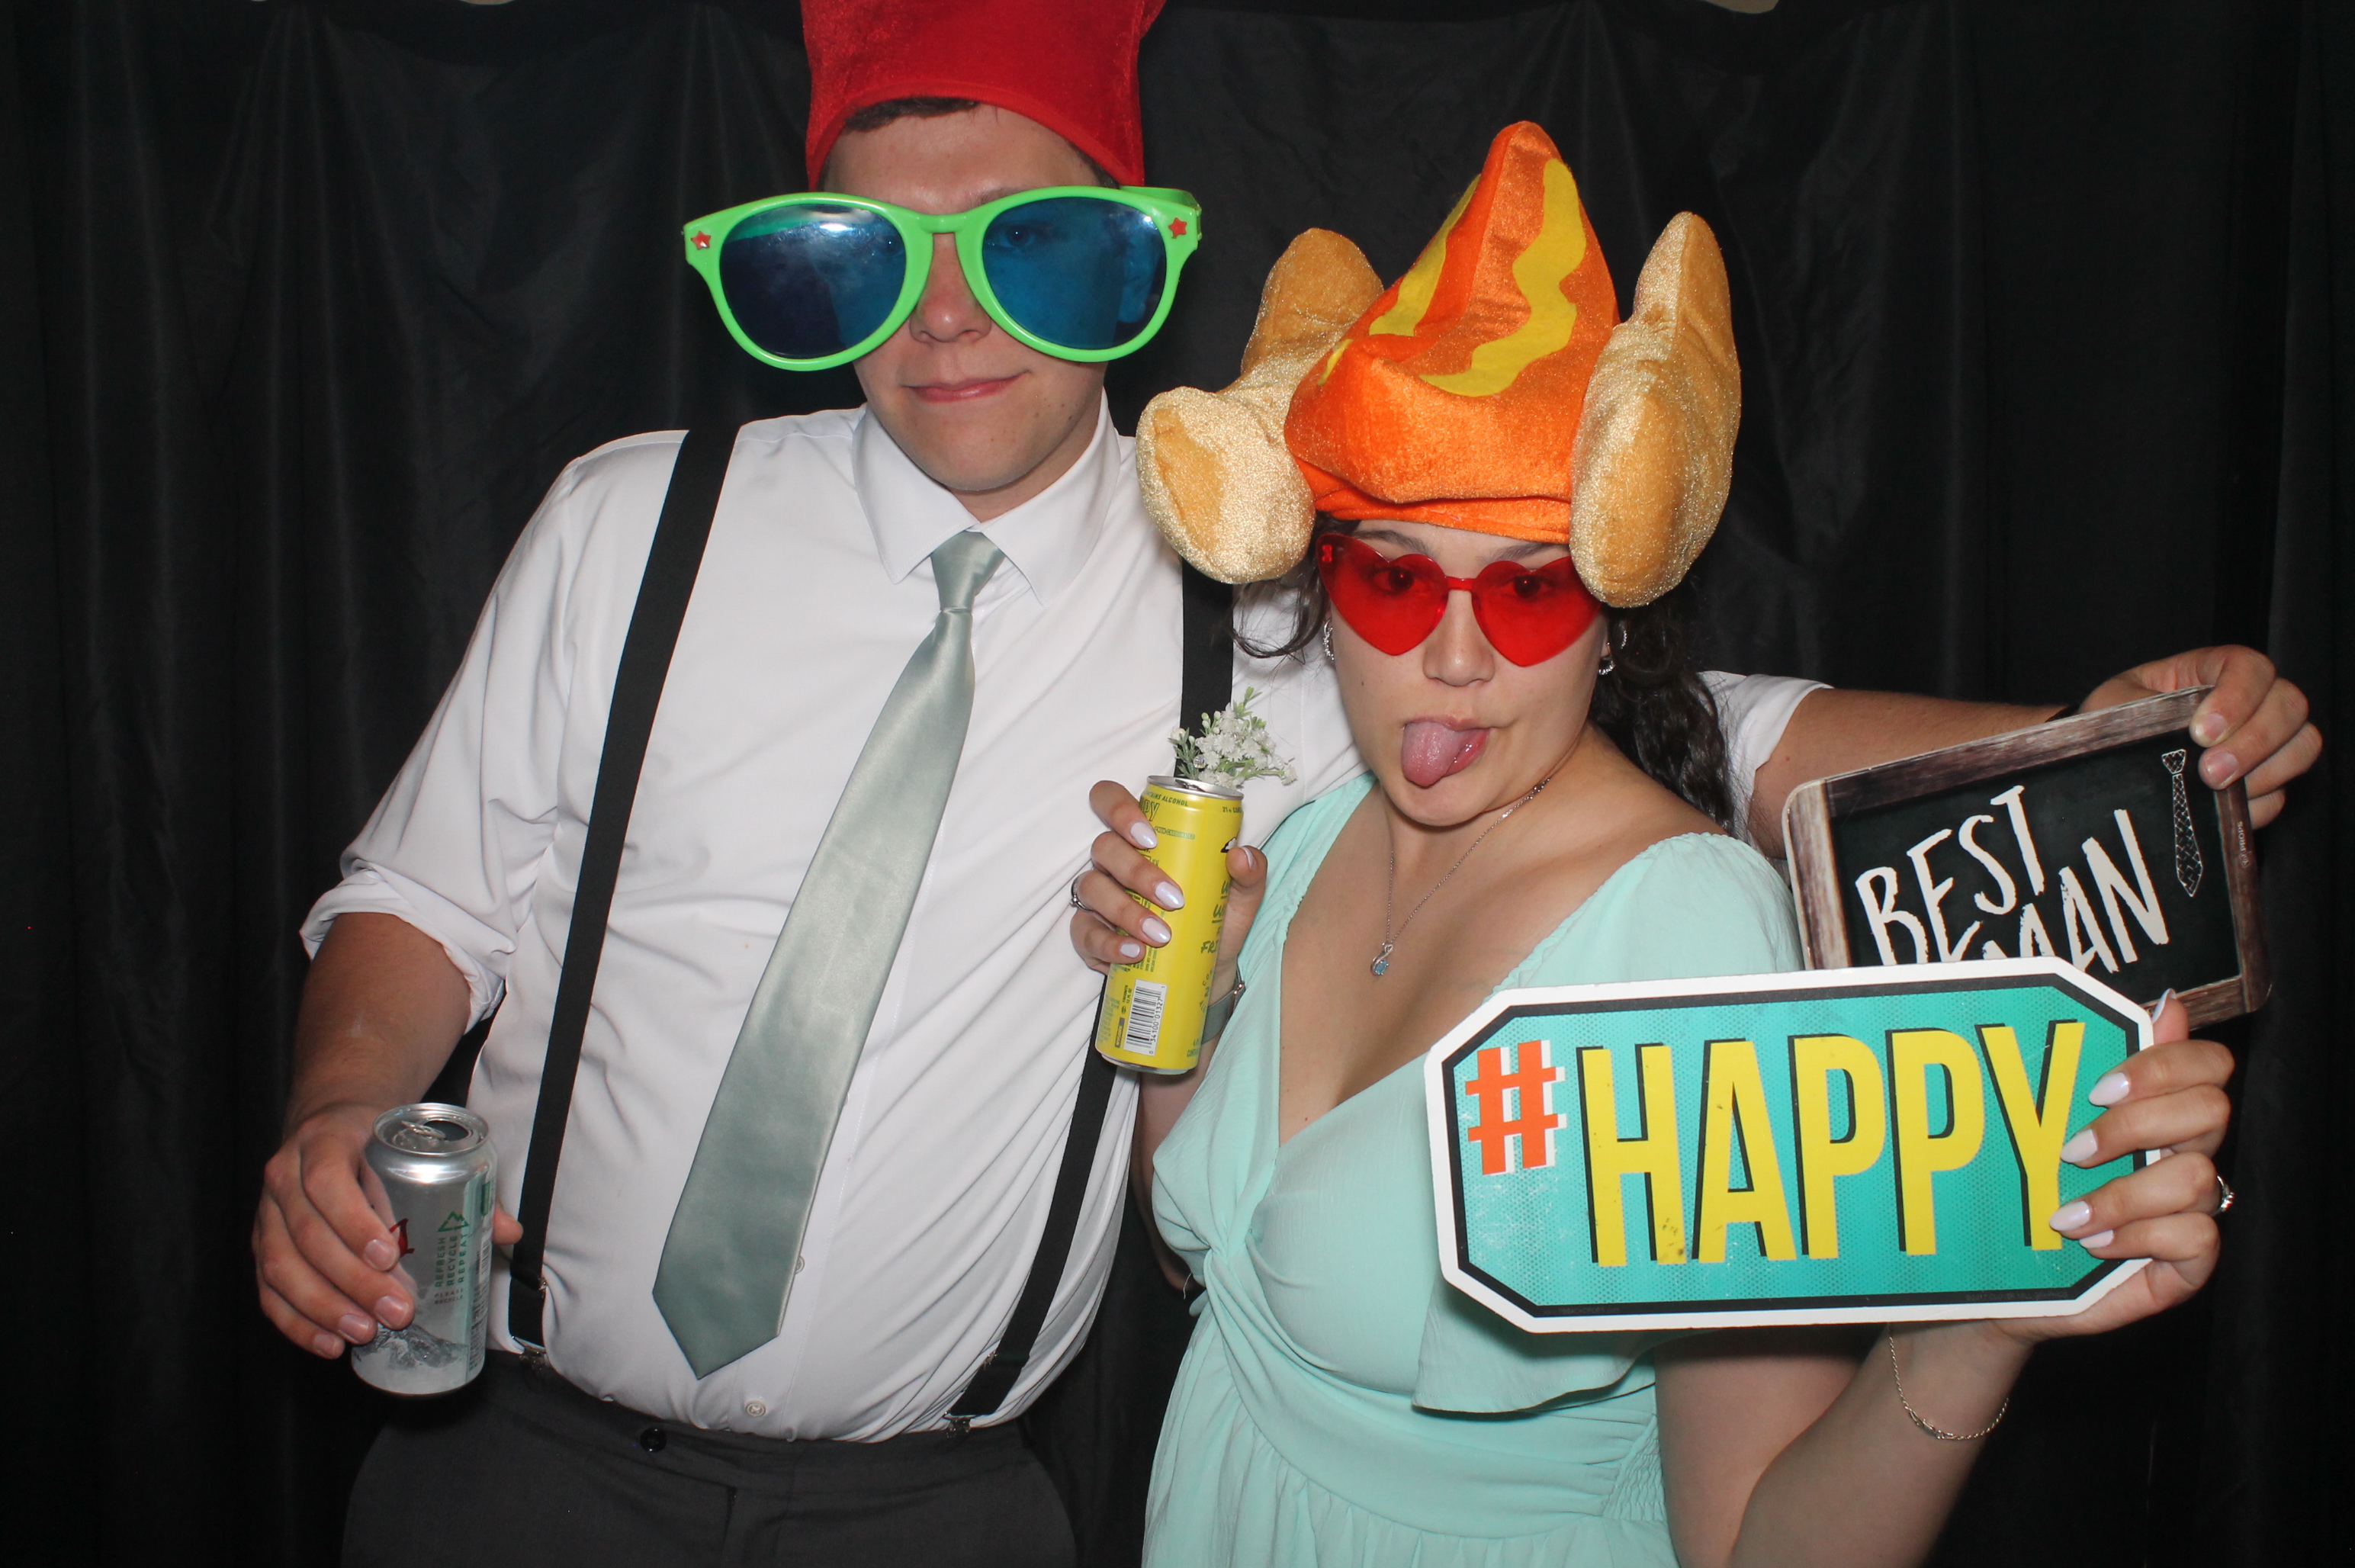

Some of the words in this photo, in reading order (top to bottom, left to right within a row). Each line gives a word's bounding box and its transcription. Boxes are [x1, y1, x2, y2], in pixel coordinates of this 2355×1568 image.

[1161, 795, 1189, 807] ALCOHOL
[1855, 786, 2045, 965] BEST
[1155, 997, 1163, 1019] 01327
[435, 1237, 445, 1287] REFRESH
[446, 1235, 458, 1287] RECYCLE
[458, 1233, 467, 1284] REPEAT
